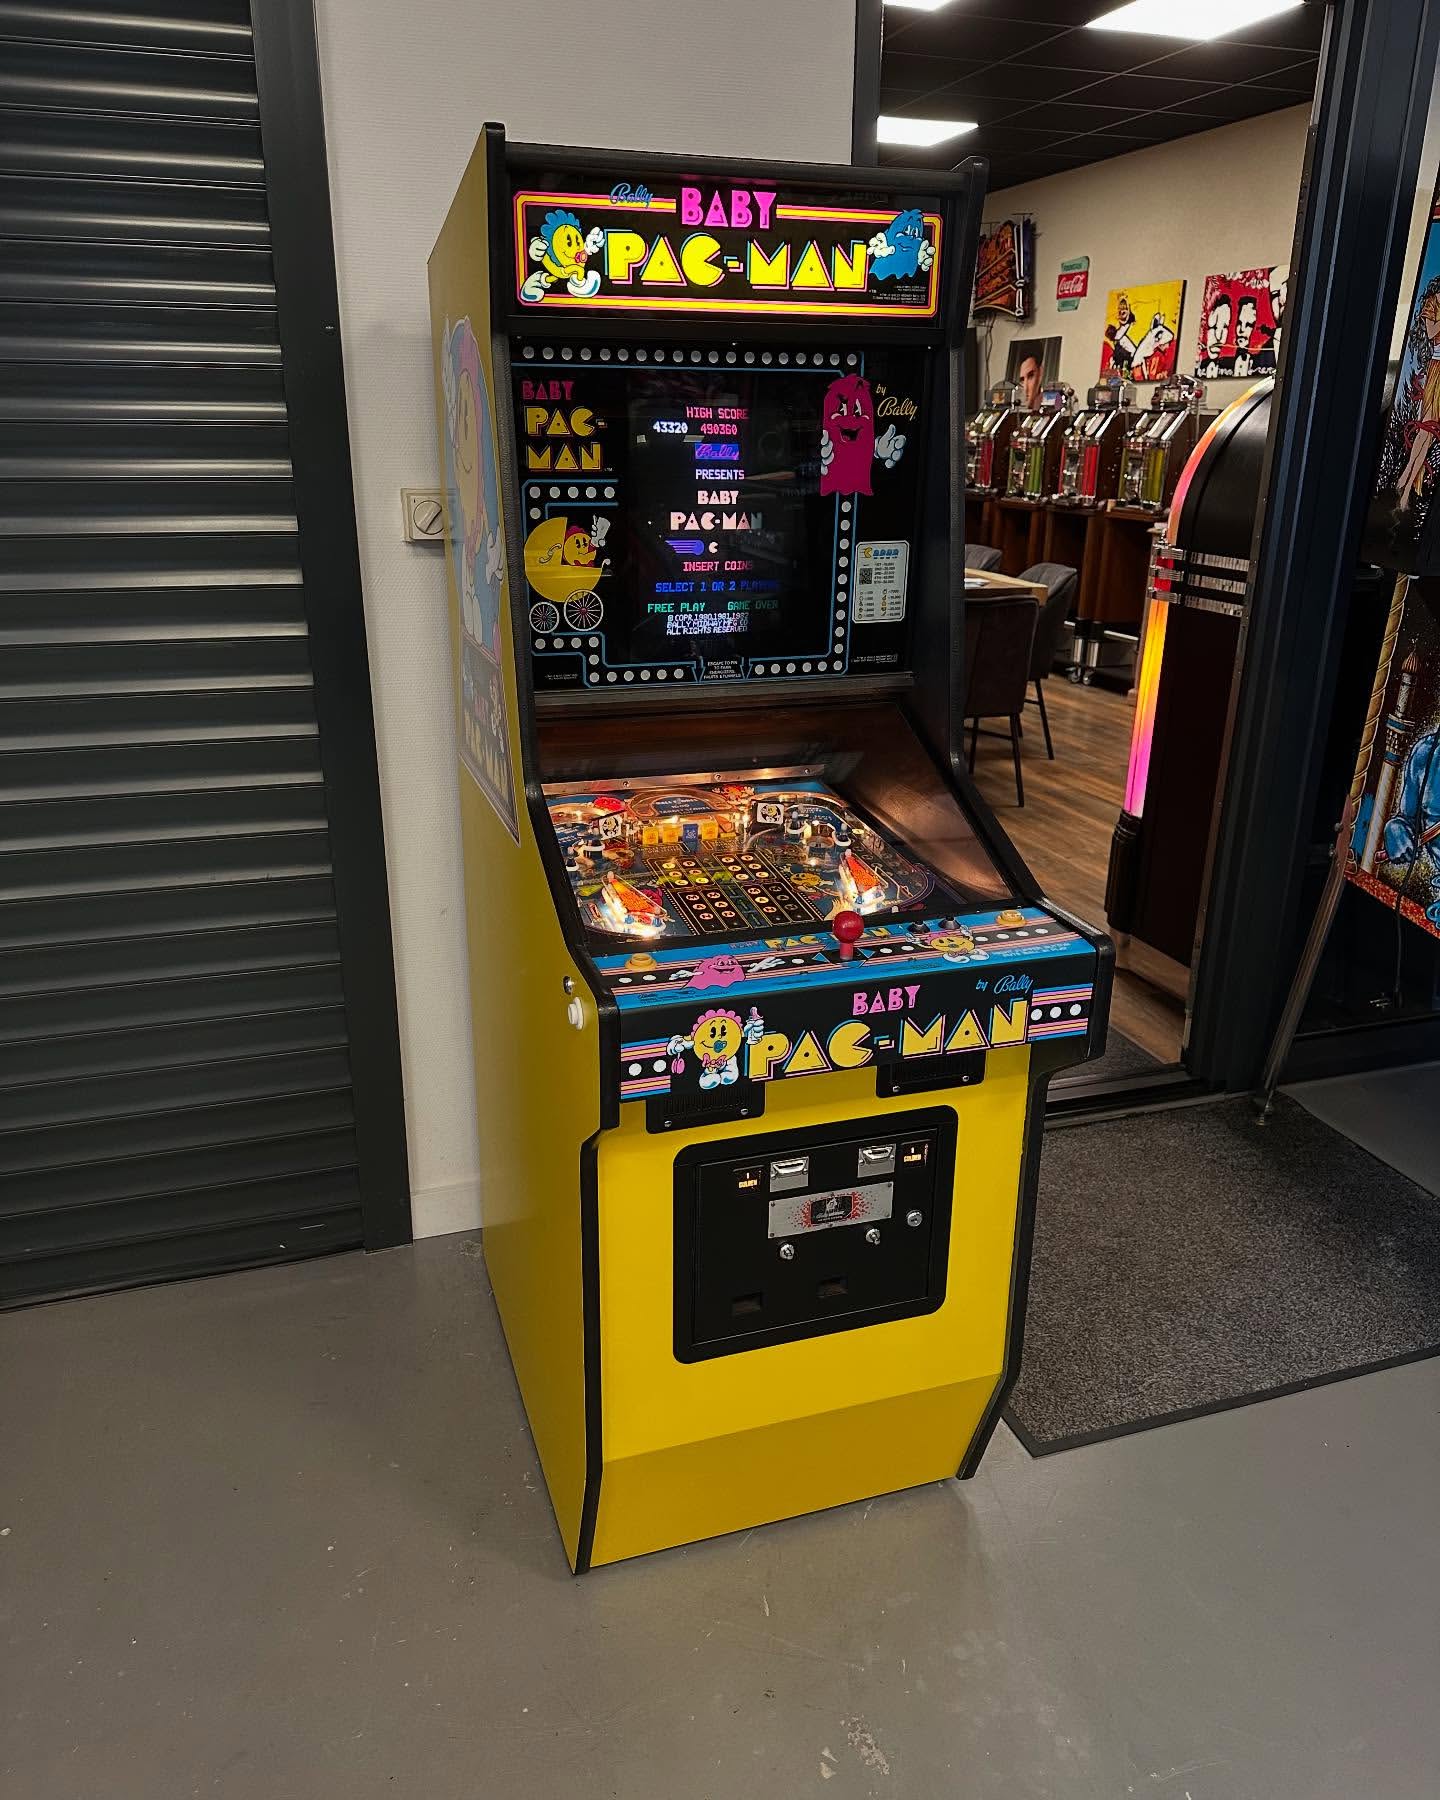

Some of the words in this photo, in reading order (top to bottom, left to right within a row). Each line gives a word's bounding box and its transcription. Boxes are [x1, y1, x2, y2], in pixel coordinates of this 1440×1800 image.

[609, 182, 654, 209] Bally
[682, 187, 776, 230] BABY
[604, 229, 868, 292] PAC-MAN
[522, 380, 575, 400] BABY
[876, 383, 887, 396] by
[686, 406, 713, 419] HIGH
[718, 408, 749, 419] SCORE
[877, 396, 918, 421] Bally
[524, 406, 607, 437] PAC-
[653, 421, 688, 434] 43320
[700, 423, 738, 435] 490360
[526, 442, 603, 471] MAN
[696, 444, 740, 460] Bally
[695, 469, 745, 480] PRESENTS
[697, 490, 739, 505] BABY
[670, 511, 762, 531] PAC-MAN
[683, 561, 719, 572] INSERT
[655, 582, 695, 593] SELECT
[700, 582, 706, 592] 1
[712, 582, 724, 592] OR
[729, 581, 736, 591] 2
[647, 603, 674, 613] FREE
[680, 603, 706, 613] PLAY
[727, 601, 750, 611] GAME
[755, 600, 779, 610] OVER
[667, 621, 691, 629] BALLY
[693, 620, 723, 628] MIDWAY
[667, 627, 681, 636] ALL
[683, 627, 711, 635] RIGHTS
[713, 625, 748, 634] RESERVED
[975, 979, 989, 992] by
[993, 974, 1034, 994] Bally
[852, 985, 921, 1016] BABY
[743, 998, 1029, 1082] PAC-MAN
